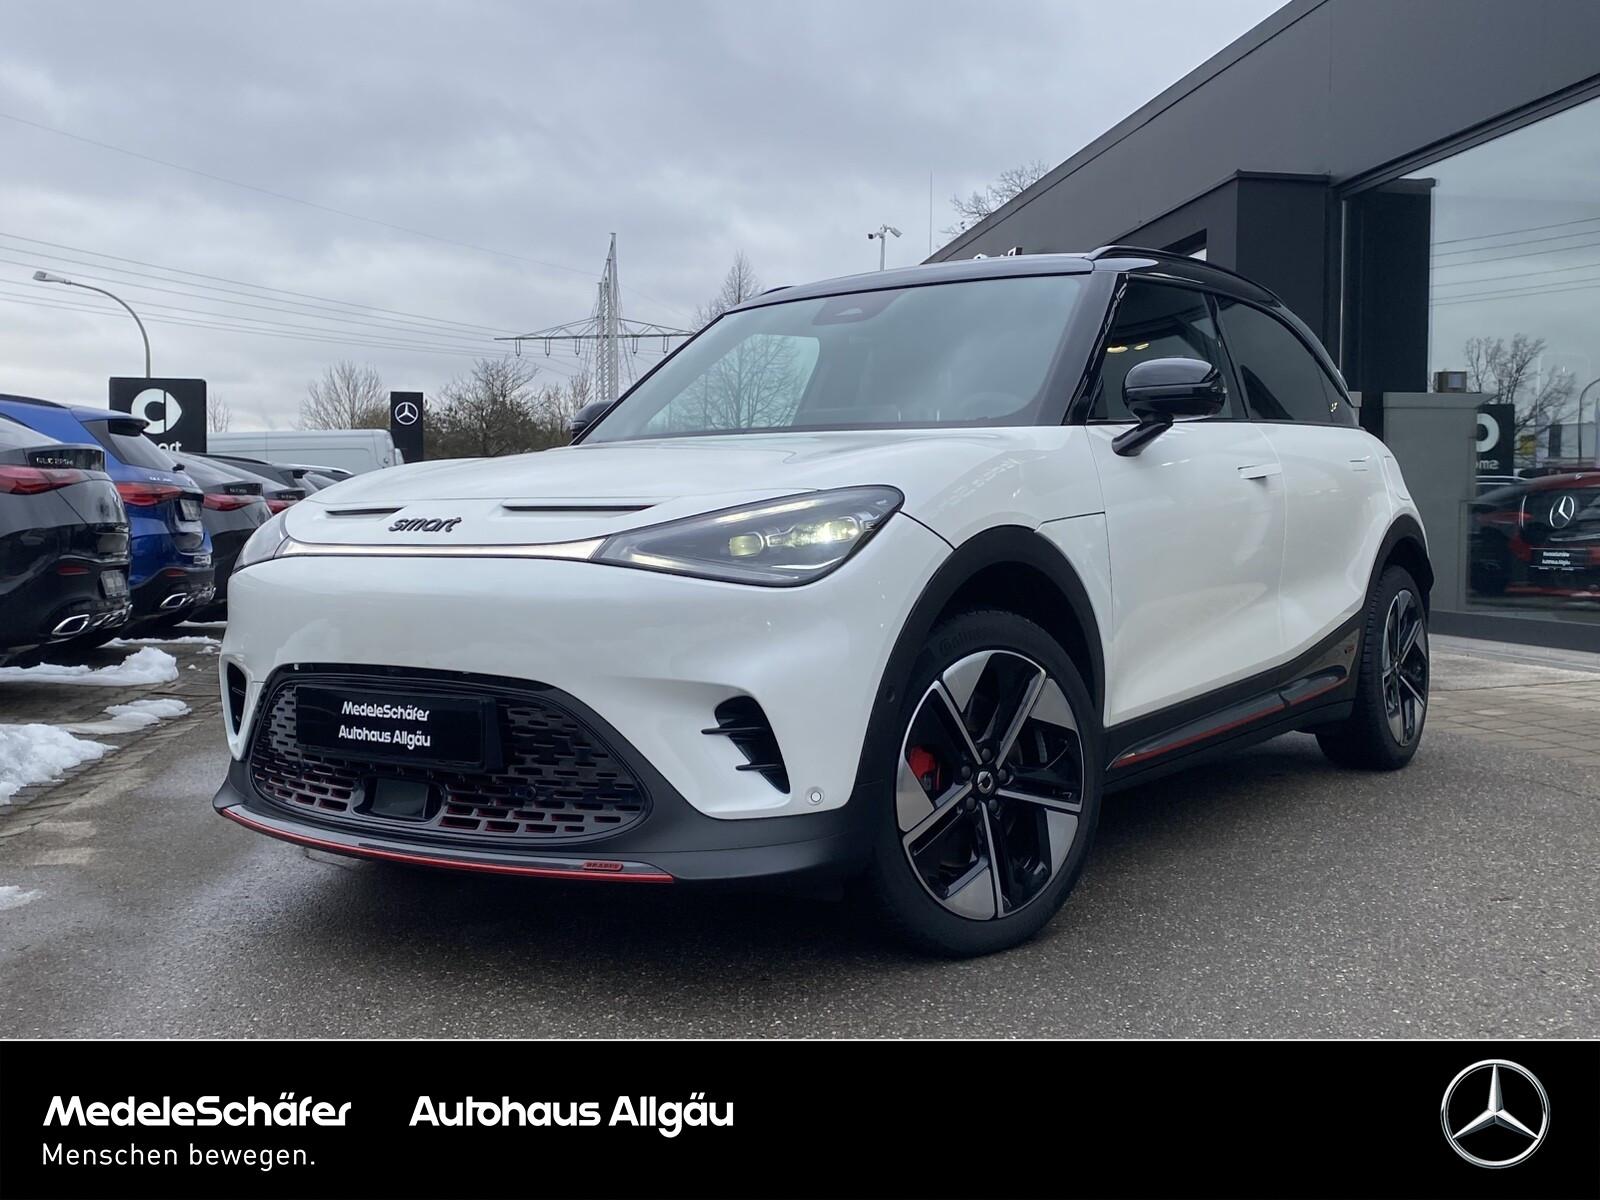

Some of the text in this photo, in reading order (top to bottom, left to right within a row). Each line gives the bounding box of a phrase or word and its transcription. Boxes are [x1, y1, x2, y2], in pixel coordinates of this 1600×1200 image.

[158, 441, 182, 453] art
[388, 516, 462, 533] smart
[341, 701, 430, 721] MedeleSchäfer
[338, 724, 431, 750] Autohaus Allgäu
